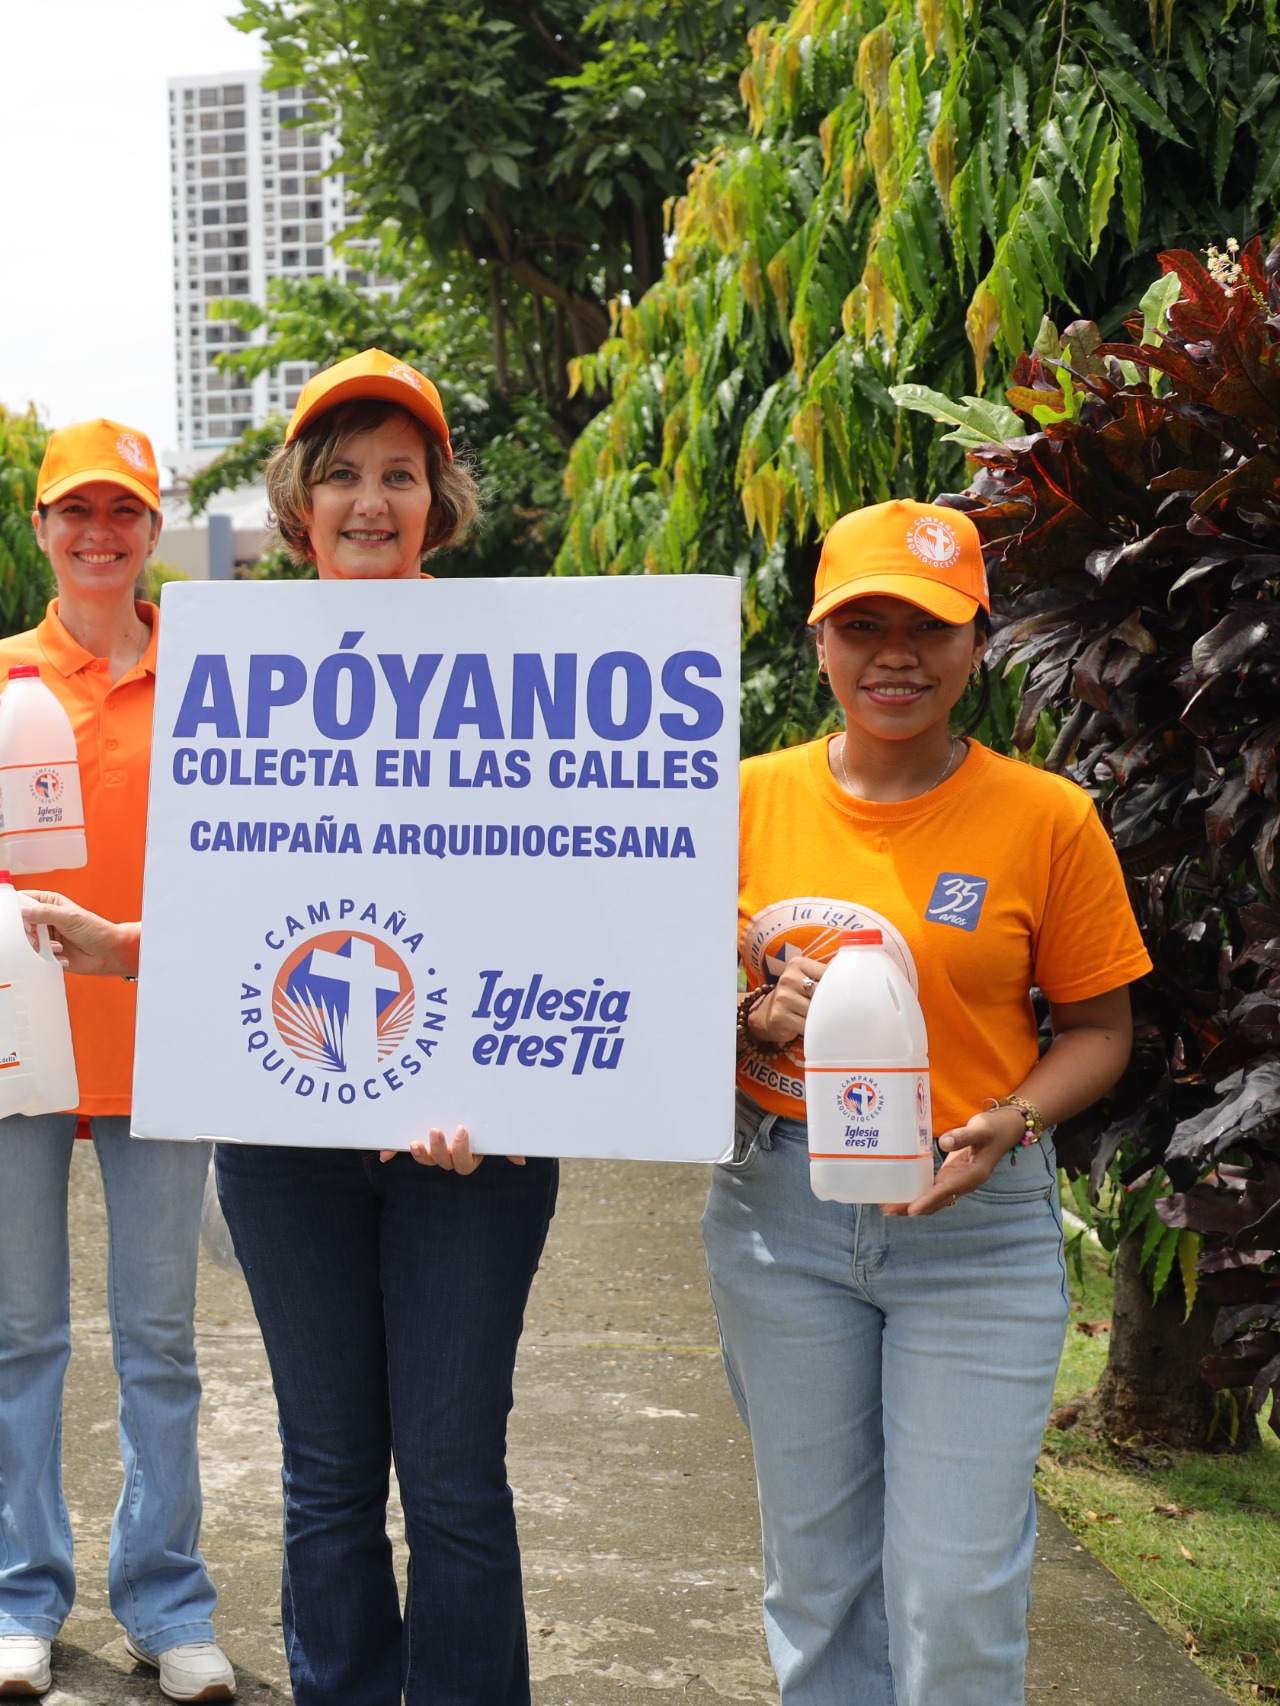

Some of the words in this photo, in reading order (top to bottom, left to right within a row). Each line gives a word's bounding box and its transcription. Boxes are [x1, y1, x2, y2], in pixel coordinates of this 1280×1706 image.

[906, 531, 961, 568] ARQUIDIOCESANA
[172, 631, 724, 742] APÓYANOS
[173, 747, 358, 787] COLECTA
[375, 749, 431, 787] EN
[449, 749, 531, 788] LAS
[548, 750, 719, 790] CALLES
[38, 806, 62, 816] Iglesia
[190, 815, 362, 854] CAMPAÑA
[372, 824, 696, 859] ARQUIDIOCESANA
[792, 906, 812, 921] la
[928, 878, 986, 914] 35
[265, 899, 424, 953] CAMPAÑA
[471, 970, 631, 1031] Iglesia
[240, 982, 448, 1104] ARQUIDIOCESANA
[837, 1095, 884, 1122] ARQUIDIOCESANA
[845, 1126, 879, 1139] Iglesia
